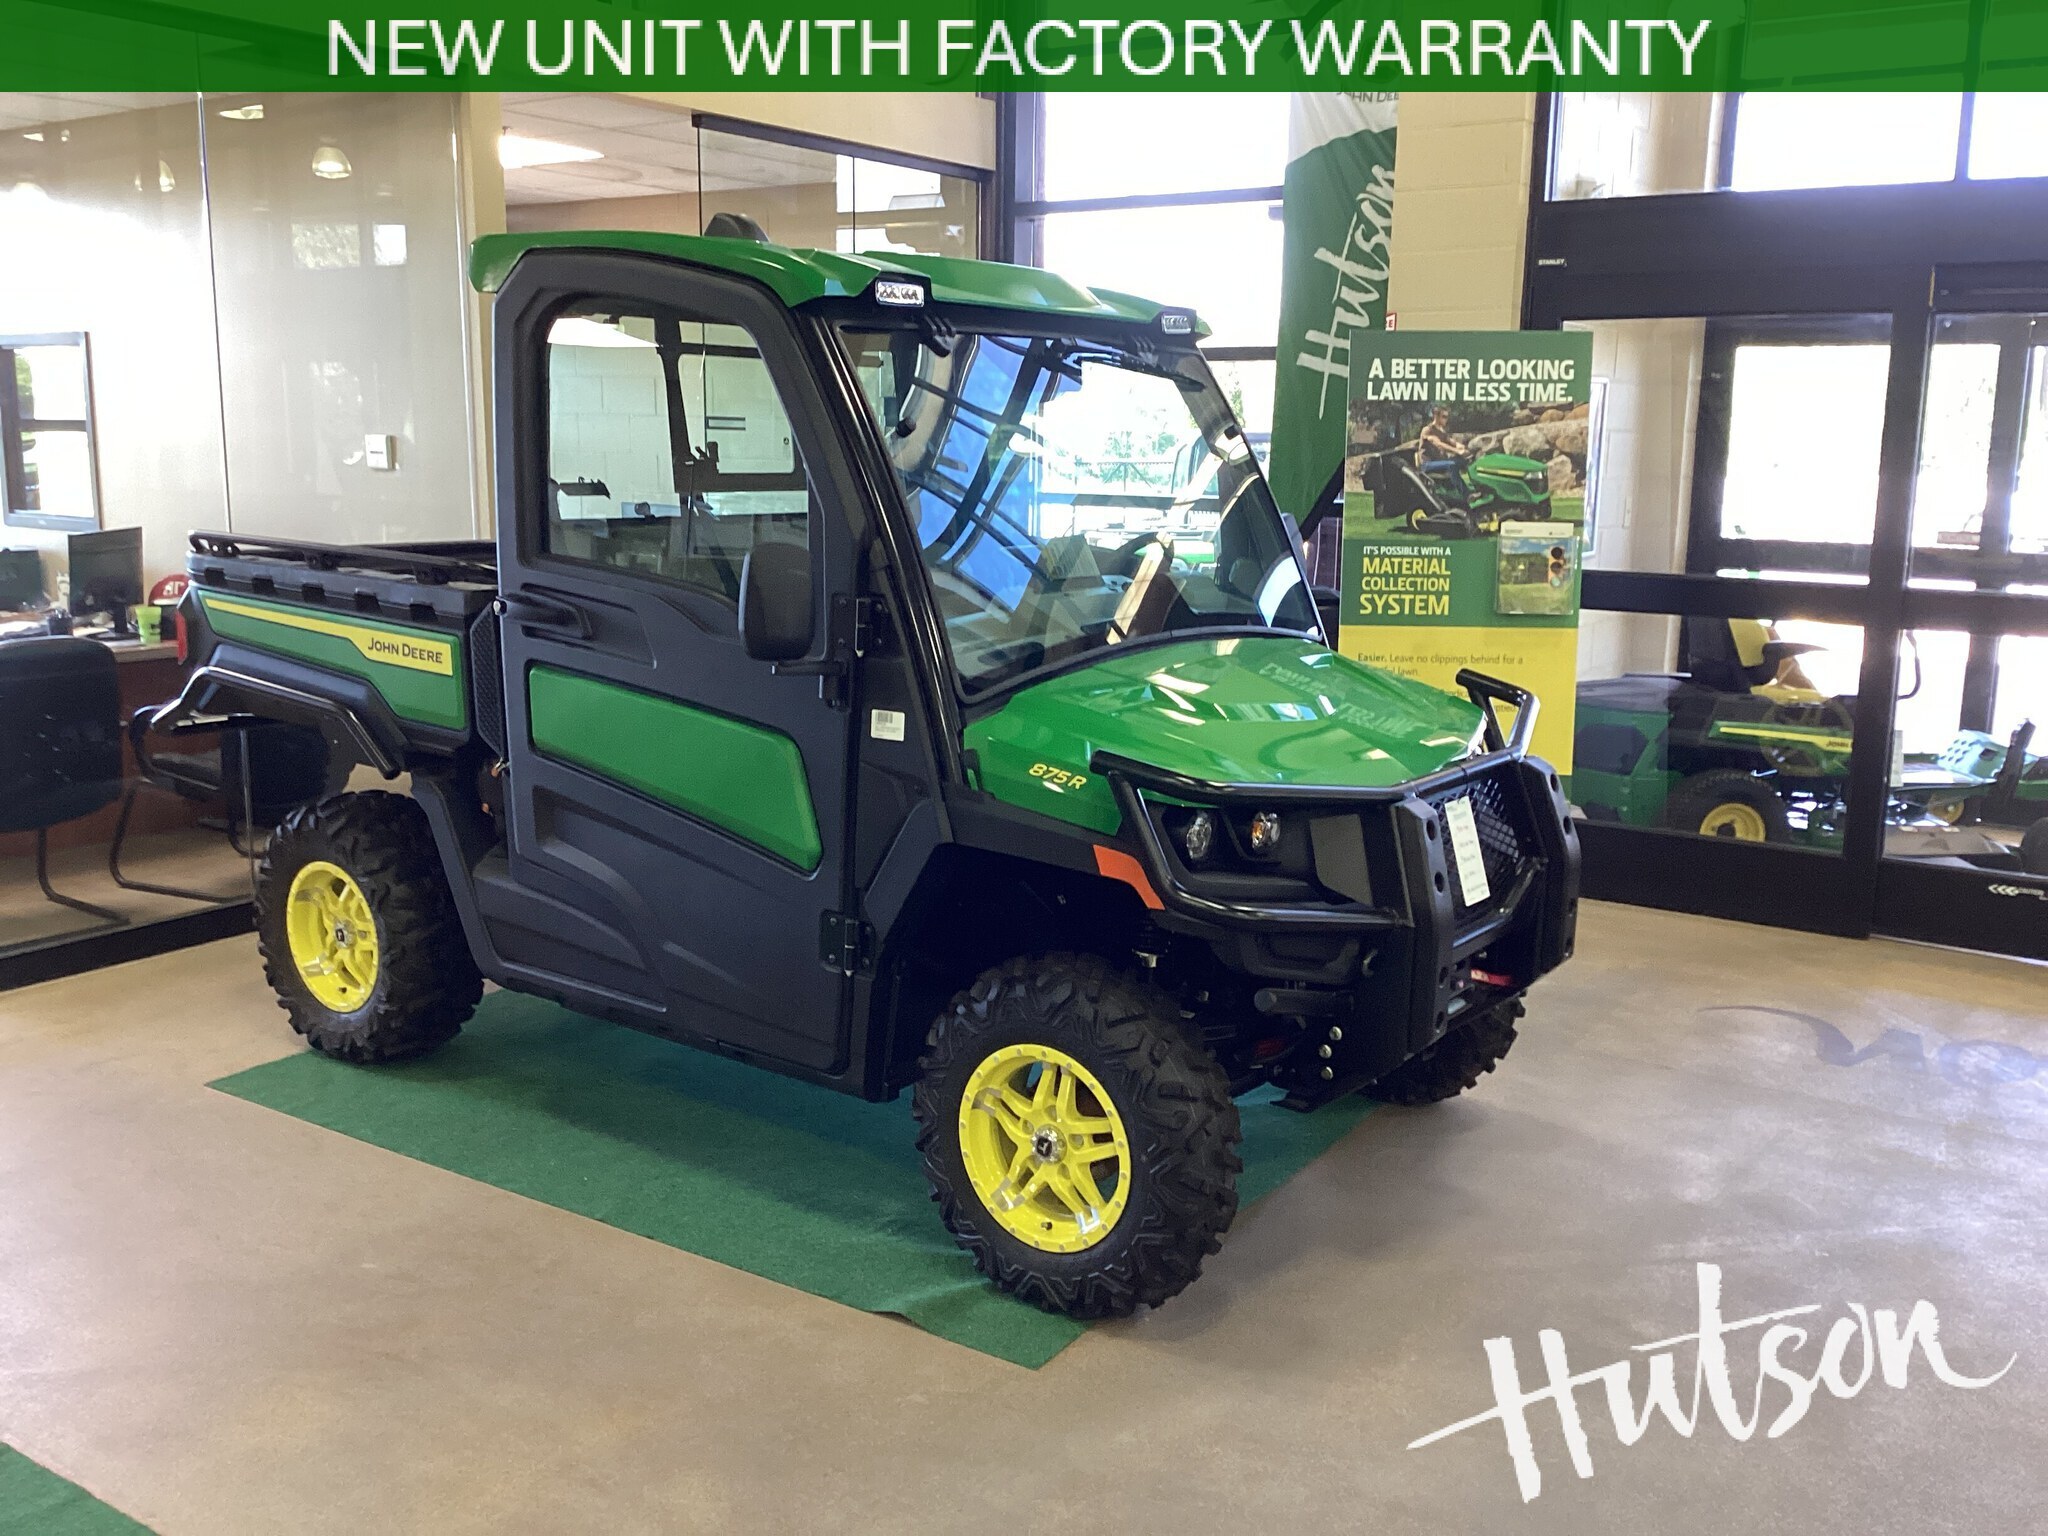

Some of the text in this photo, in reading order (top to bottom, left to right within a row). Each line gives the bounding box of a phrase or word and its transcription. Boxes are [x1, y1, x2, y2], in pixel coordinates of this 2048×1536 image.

[1296, 164, 1395, 420] Hutson
[1368, 358, 1575, 380] A BETTER LOOKING
[1367, 381, 1573, 402] LAWN IN LESS TIME.
[1363, 546, 1452, 556] IT'S POSSIBLE WITH A
[1362, 557, 1451, 575] MATERIAL
[1361, 576, 1450, 592] COLLECTION
[1360, 593, 1450, 616] SYSTEM
[367, 637, 443, 664] JOHN DEERE
[1358, 653, 1524, 666] Easier. Leave no clippings behind for a
[1028, 763, 1087, 790] 875R
